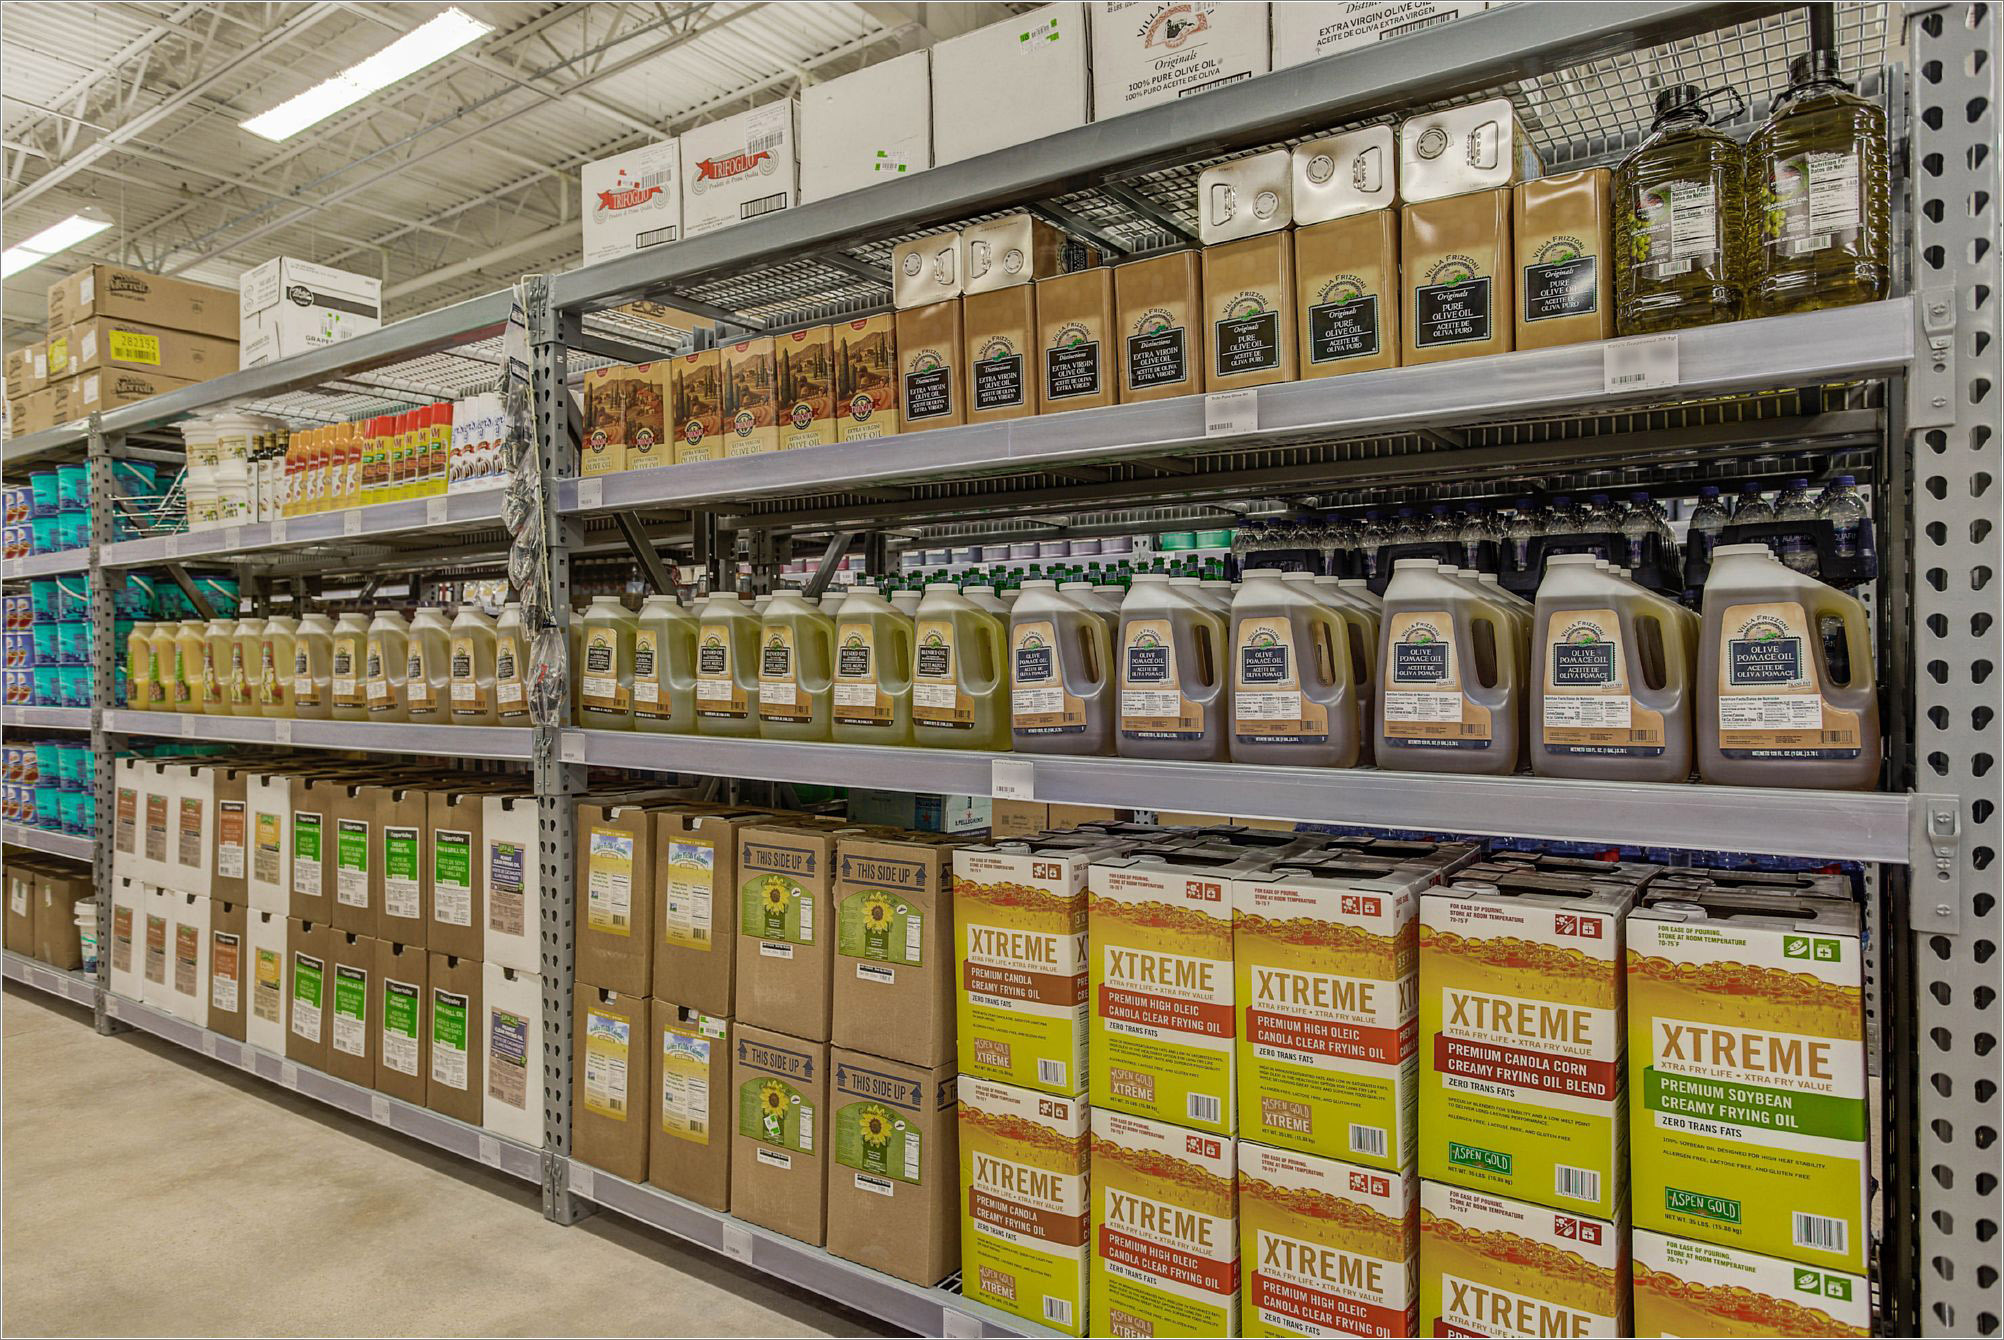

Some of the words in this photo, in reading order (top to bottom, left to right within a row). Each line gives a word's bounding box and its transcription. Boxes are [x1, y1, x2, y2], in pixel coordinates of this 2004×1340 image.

[1137, 6, 1164, 37] VILLA
[1317, 34, 1342, 45] ACEITE
[1344, 30, 1354, 39] DE
[1355, 24, 1379, 35] OLIVA
[1380, 17, 1404, 29] EXTRA
[1406, 7, 1435, 21] VIRGEN
[1320, 21, 1349, 36] EXTRA
[1350, 14, 1382, 29] VIRGIN
[1384, 2, 1412, 22] OLIVE
[1155, 51, 1197, 70] Originals
[1125, 91, 1142, 101] 100%
[1144, 86, 1162, 95] PURO
[1163, 79, 1186, 90] ACEITE
[1188, 76, 1197, 84] DE
[1200, 68, 1220, 79] OLIVA
[1129, 79, 1150, 91] 100%
[1152, 72, 1172, 84] PURE
[1175, 64, 1199, 77] OLIVE
[1202, 59, 1216, 69] OIL
[713, 155, 754, 178] TRIFOGLIO
[614, 190, 649, 209] TRIFOGLIO
[1425, 259, 1444, 278] VILLA
[1446, 255, 1479, 270] FRIZZONI
[1317, 280, 1333, 298] VILLA
[1336, 275, 1366, 288] FRIZZONI
[1438, 290, 1468, 301] Originals
[1329, 309, 1356, 318] Originals
[1432, 311, 1457, 321] OLIVE
[1459, 309, 1473, 317] OIL
[1442, 302, 1463, 311] PURE
[1134, 310, 1148, 329] VILLA
[1149, 308, 1176, 321] FRIZZONI
[1334, 319, 1353, 328] PURE
[1436, 322, 1458, 330] ACEITE
[1326, 327, 1348, 337] OLIVE
[1349, 325, 1362, 333] OIL
[1433, 329, 1453, 337] OLIVA
[1134, 350, 1152, 360] EXTRA
[1154, 347, 1178, 357] VIRGIN
[1141, 340, 1170, 348] Distinctions
[1141, 357, 1158, 365] OLIVE
[788, 439, 806, 450] OLIVE
[1560, 622, 1576, 638] VILLA
[1577, 621, 1604, 636] FRIZZONI
[1737, 618, 1755, 633] VILLA
[1757, 615, 1790, 631] FRIZZONI
[1560, 656, 1593, 664] POMACE
[1737, 654, 1776, 662] POMACE
[1778, 653, 1794, 661] OIL
[1751, 645, 1779, 654] OLIVE
[757, 851, 771, 866] THIS
[773, 853, 789, 868] SIDE
[792, 856, 802, 869] UP
[858, 863, 875, 878] THIS
[878, 866, 896, 881] SIDE
[899, 869, 910, 883] UP
[972, 928, 1057, 964] XTREME
[1704, 937, 1746, 946] TEMPERATURE
[971, 968, 1002, 981] PREMIUM
[1005, 974, 1031, 985] CANOLA
[1110, 950, 1214, 992] XTREME
[972, 981, 998, 993] CREAMY
[1000, 985, 1026, 998] FRYING
[1028, 989, 1040, 1000] OIL
[1258, 970, 1376, 1015] XTREME
[1109, 992, 1147, 1007] PREMIUM
[1150, 1000, 1171, 1012] HIGH
[1174, 1003, 1199, 1016] OLEIC
[1109, 1005, 1140, 1020] CANOLA
[1142, 1012, 1169, 1024] CLEAR
[1172, 1017, 1203, 1030] FRYING
[1207, 1022, 1221, 1033] OIL
[1258, 1016, 1301, 1031] PREMIUM
[1304, 1024, 1328, 1036] HIGH
[1331, 1028, 1360, 1040] OLEIC
[1450, 993, 1592, 1045] XTREME
[1258, 1030, 1293, 1045] CANOLA
[1295, 1038, 1325, 1050] CLEAR
[1329, 1043, 1365, 1057] FRYING
[1369, 1047, 1386, 1059] OIL
[1259, 1048, 1275, 1056] ZERO
[1277, 1051, 1297, 1060] TRANS
[1299, 1055, 1313, 1063] FATS
[1661, 1024, 1832, 1080] XTREME
[1448, 1043, 1501, 1062] PREMIUM
[1505, 1053, 1550, 1071] CANOLA
[1554, 1061, 1587, 1076] CORN
[852, 1074, 870, 1092] THIS
[872, 1078, 891, 1097] SIDE
[893, 1084, 905, 1100] UP
[1448, 1059, 1492, 1078] CREAMY
[1497, 1069, 1539, 1086] FRYING
[1544, 1076, 1562, 1089] OIL
[1566, 1080, 1605, 1095] BLEND
[1449, 1078, 1468, 1089] ZERO
[1471, 1082, 1495, 1094] TRANS
[1497, 1086, 1515, 1097] FATS
[1661, 1062, 1685, 1072] XTRA
[1689, 1066, 1707, 1075] FRY
[1711, 1069, 1732, 1078] LIFE
[1744, 1073, 1771, 1083] XTRA
[1775, 1078, 1793, 1086] FRY
[1798, 1081, 1832, 1092] VALUE
[1661, 1078, 1724, 1100] PREMIUM
[1729, 1088, 1792, 1109] SOYBEAN
[1661, 1095, 1715, 1115] CREAMY
[1720, 1104, 1769, 1124] FRYING
[1775, 1113, 1798, 1128] OIL
[1662, 1117, 1685, 1128] ZERO
[1688, 1121, 1717, 1134] TRANS
[1720, 1126, 1742, 1137] FATS
[1454, 1147, 1481, 1161] ASPEN
[1485, 1153, 1508, 1170] GOLD
[977, 1155, 1063, 1203] XTREME
[1671, 1192, 1704, 1209] ASPEN
[1708, 1200, 1735, 1218] GOLD
[1110, 1192, 1213, 1248] XTREME
[1263, 1235, 1383, 1294] XTREME
